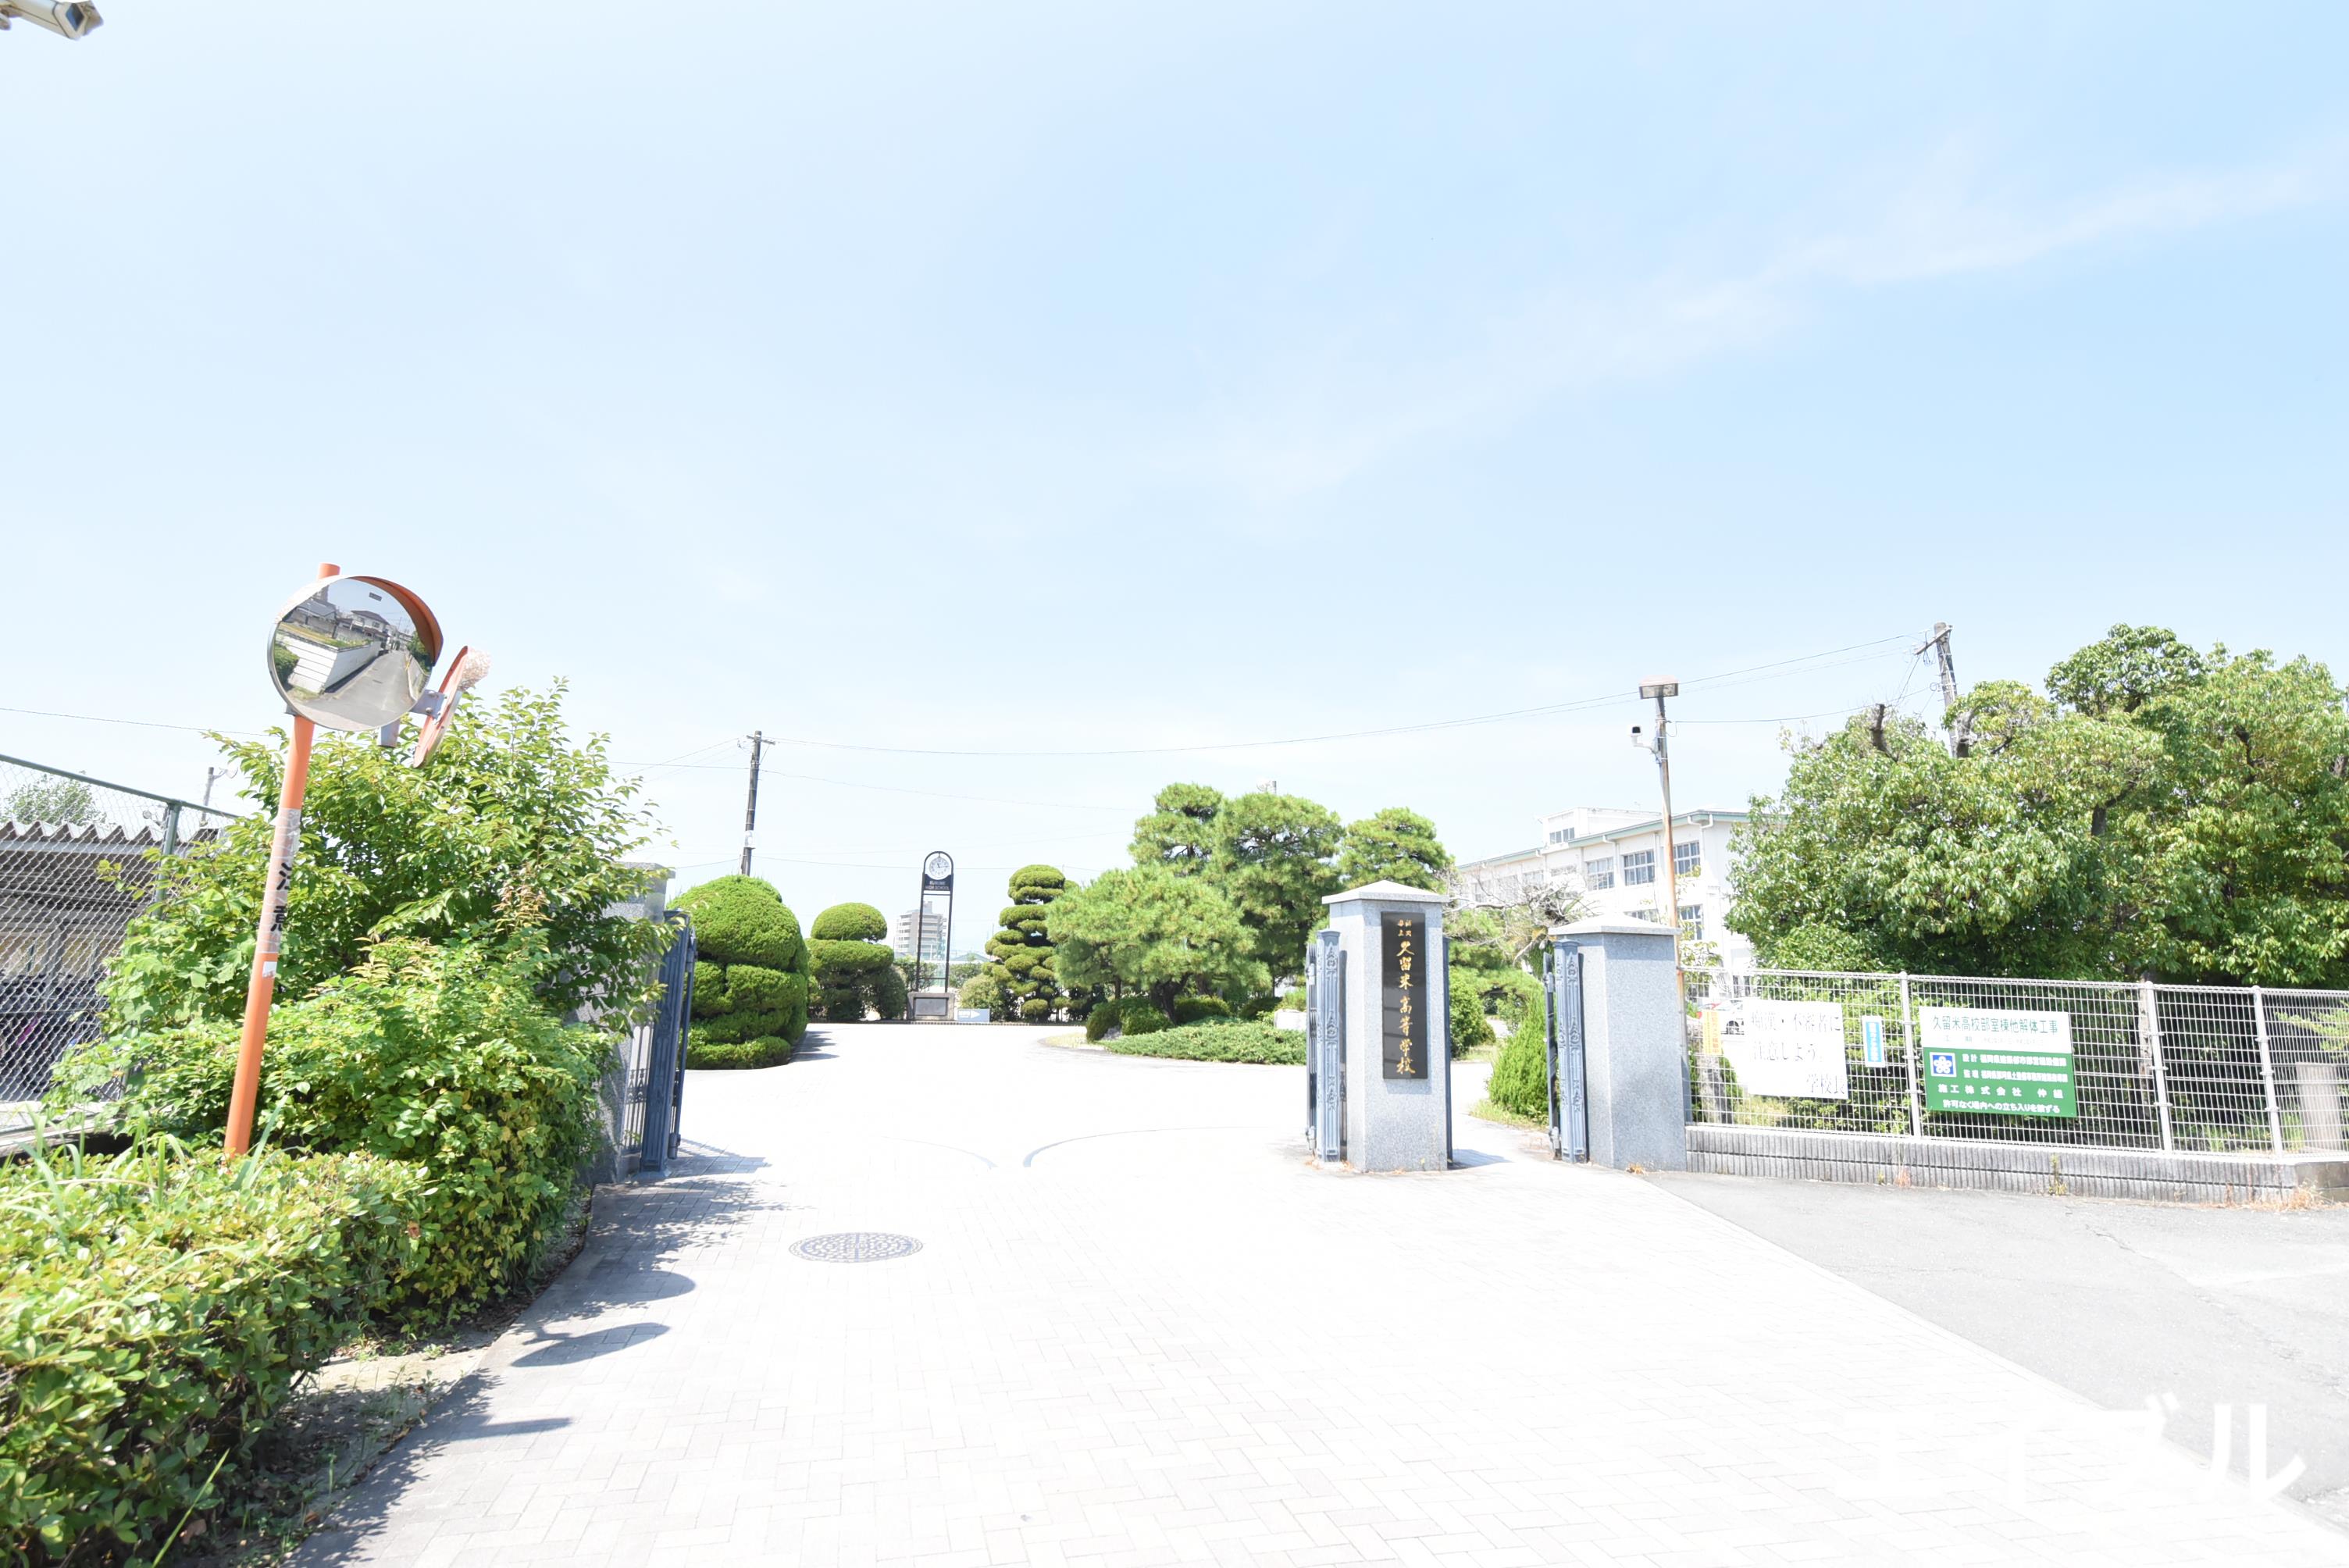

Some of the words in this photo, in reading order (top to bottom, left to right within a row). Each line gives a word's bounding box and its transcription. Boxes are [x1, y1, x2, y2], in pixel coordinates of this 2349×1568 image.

[1396, 940, 1416, 1075] 久留米高等学校
